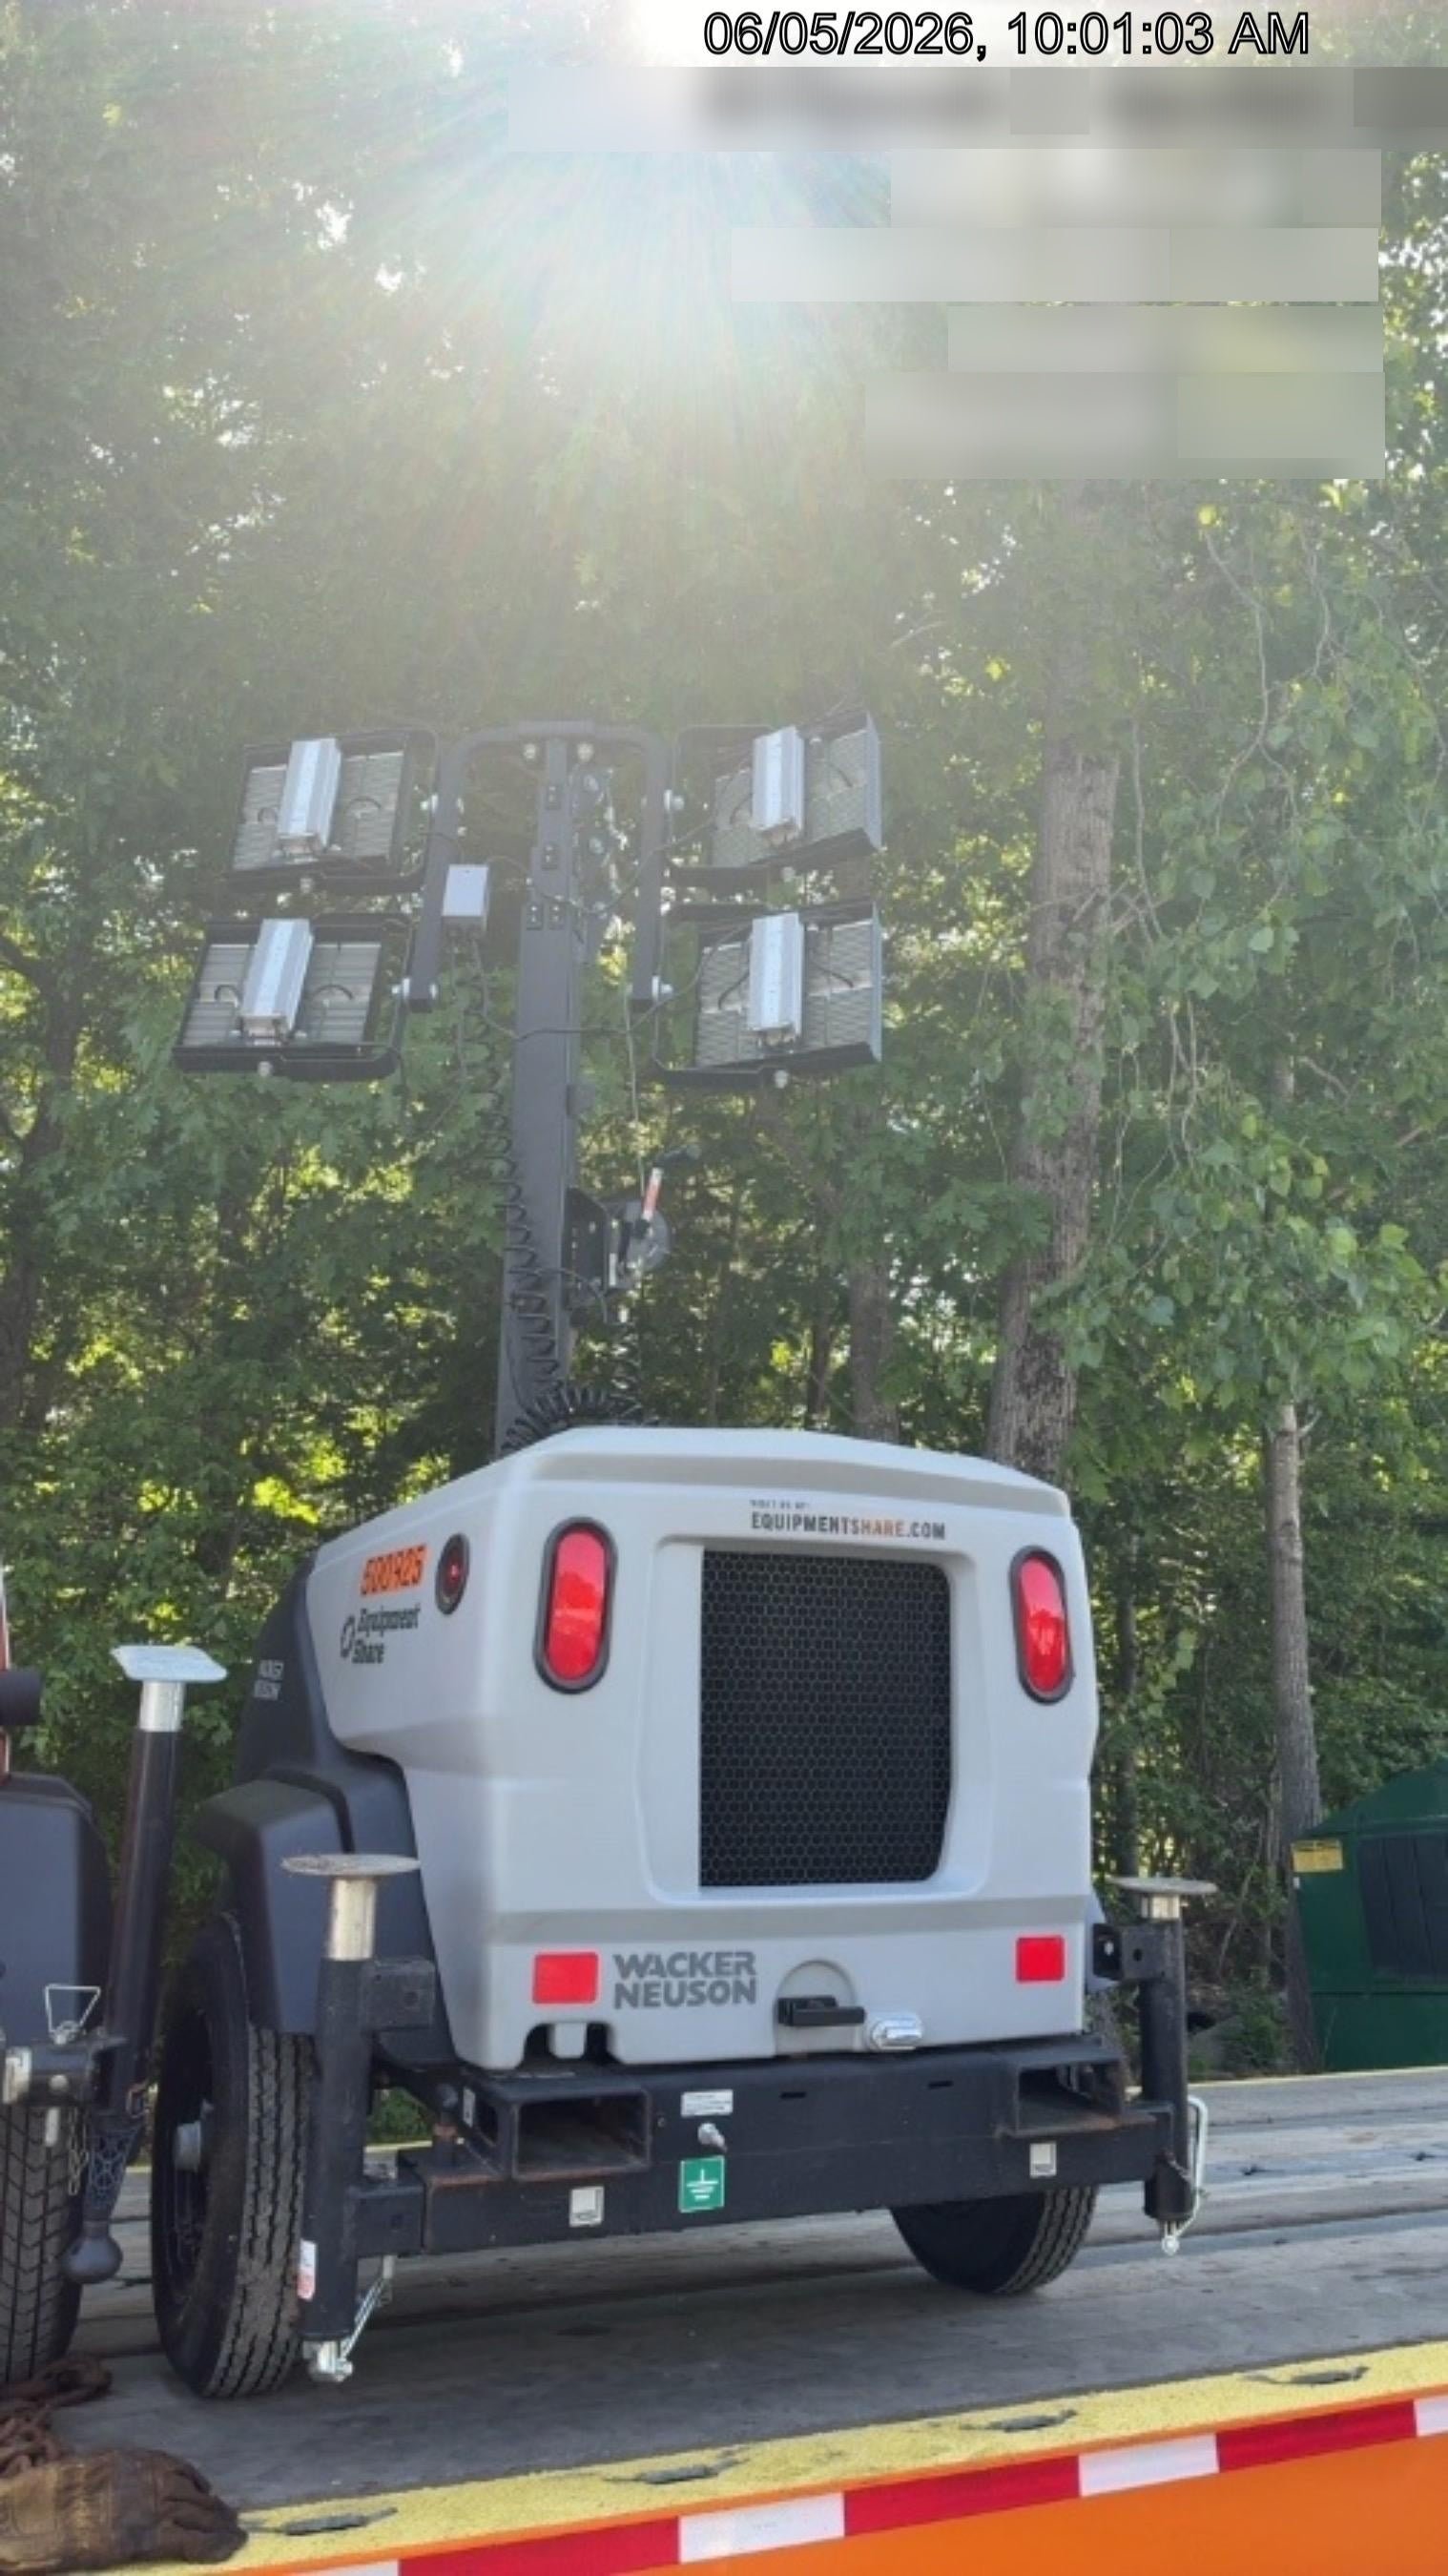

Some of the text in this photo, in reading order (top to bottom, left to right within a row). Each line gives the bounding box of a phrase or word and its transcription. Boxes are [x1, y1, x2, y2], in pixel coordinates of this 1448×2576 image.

[751, 1511, 946, 1540] EQUIPMENTSHARE.COM
[357, 1603, 421, 1638] Equipment
[351, 1639, 385, 1665] Share
[612, 1951, 757, 1980] WACKER
[613, 1977, 757, 2010] NEUSON
